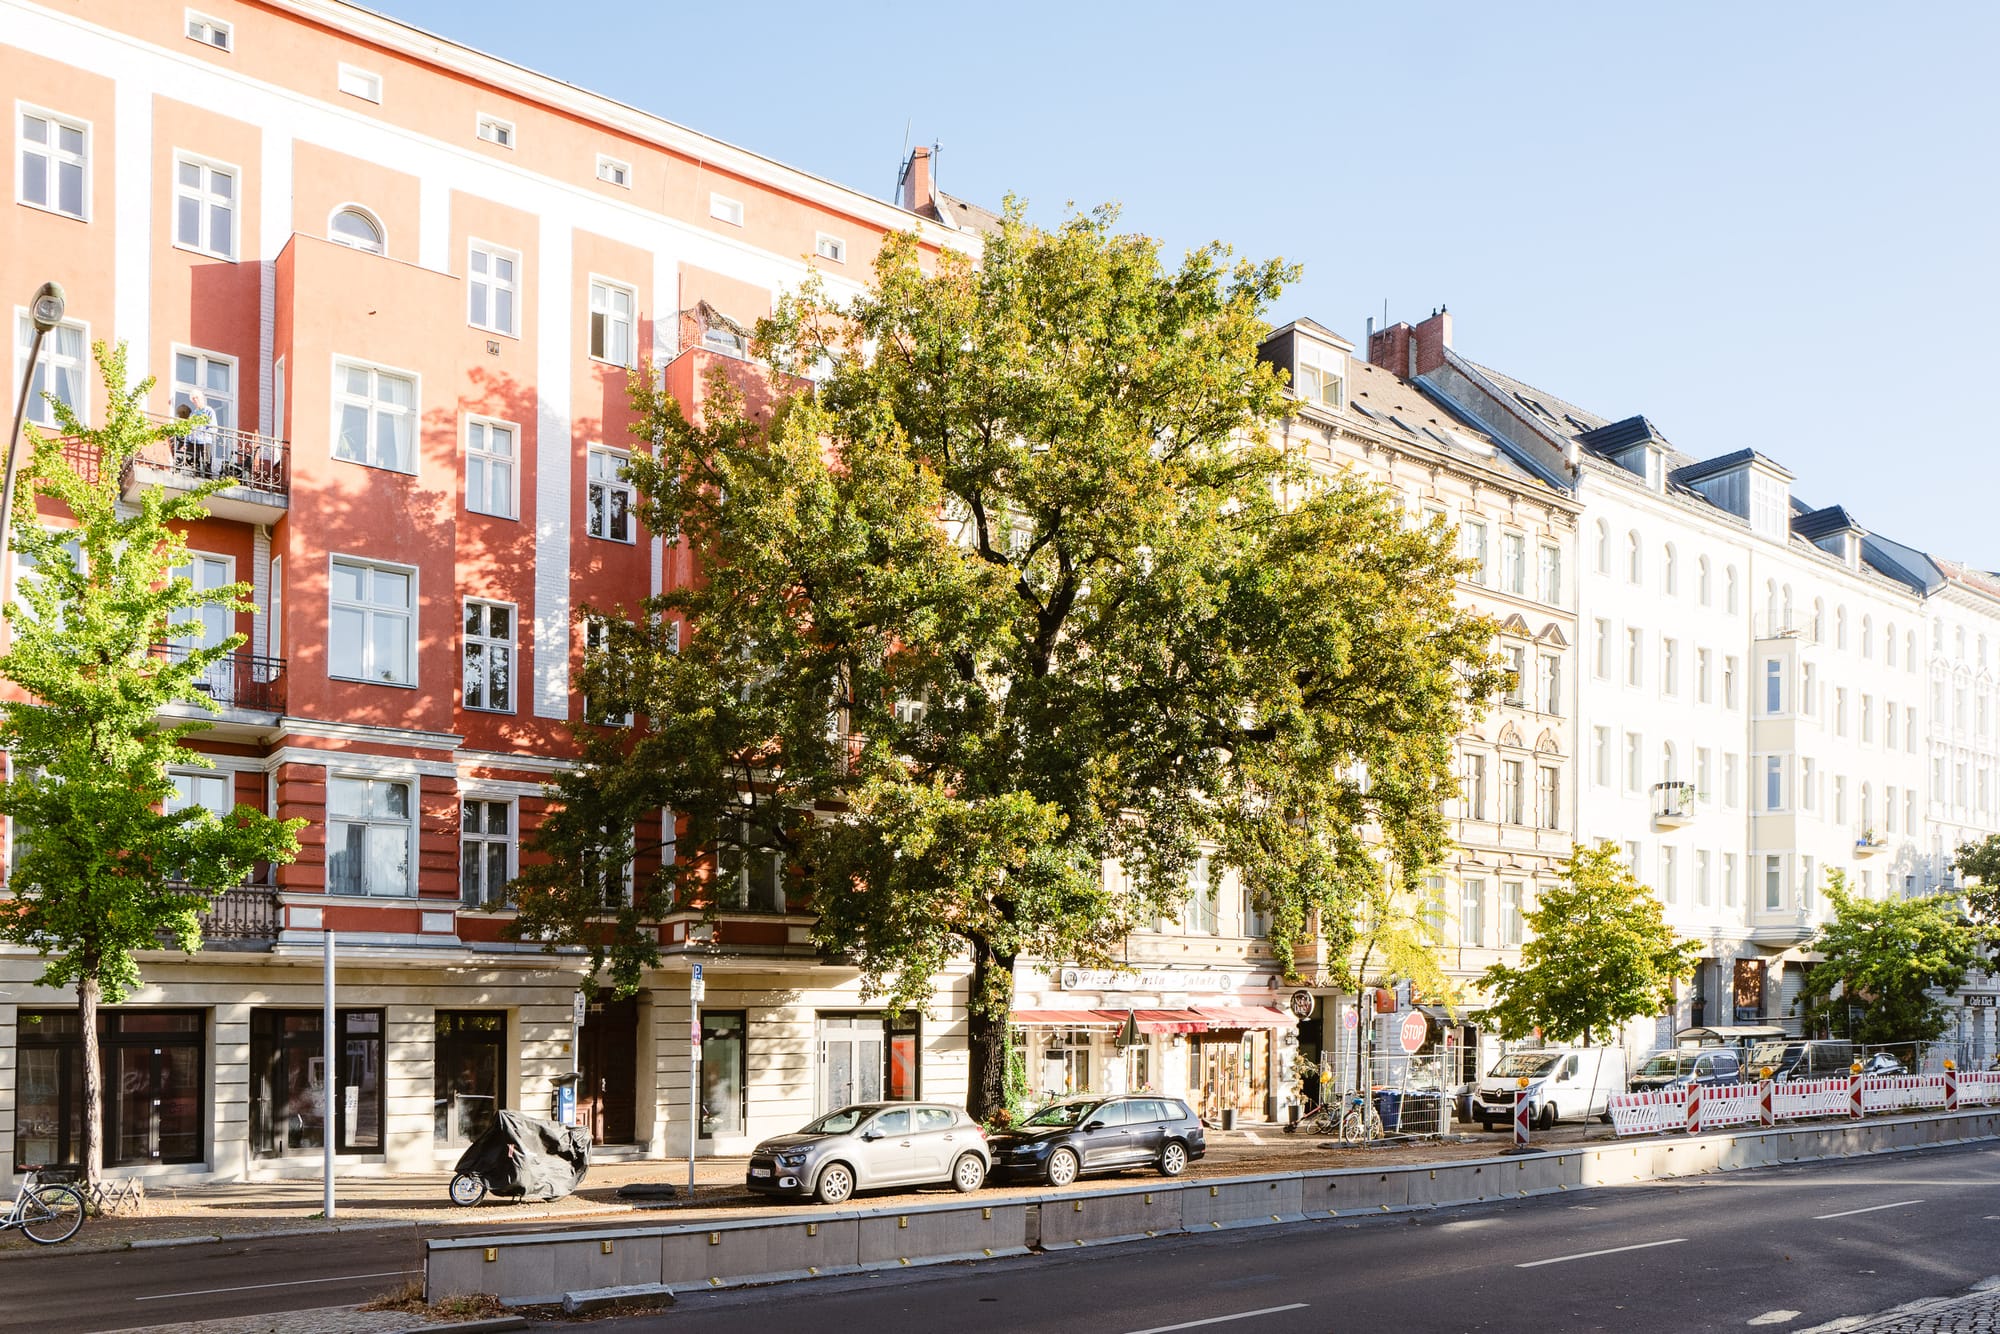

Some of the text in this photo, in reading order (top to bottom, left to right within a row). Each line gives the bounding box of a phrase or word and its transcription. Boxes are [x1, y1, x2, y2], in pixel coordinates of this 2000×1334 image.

[695, 965, 701, 978] P
[1080, 972, 1115, 985] Pizza
[1403, 1024, 1424, 1040] STOP
[565, 1088, 572, 1099] P
